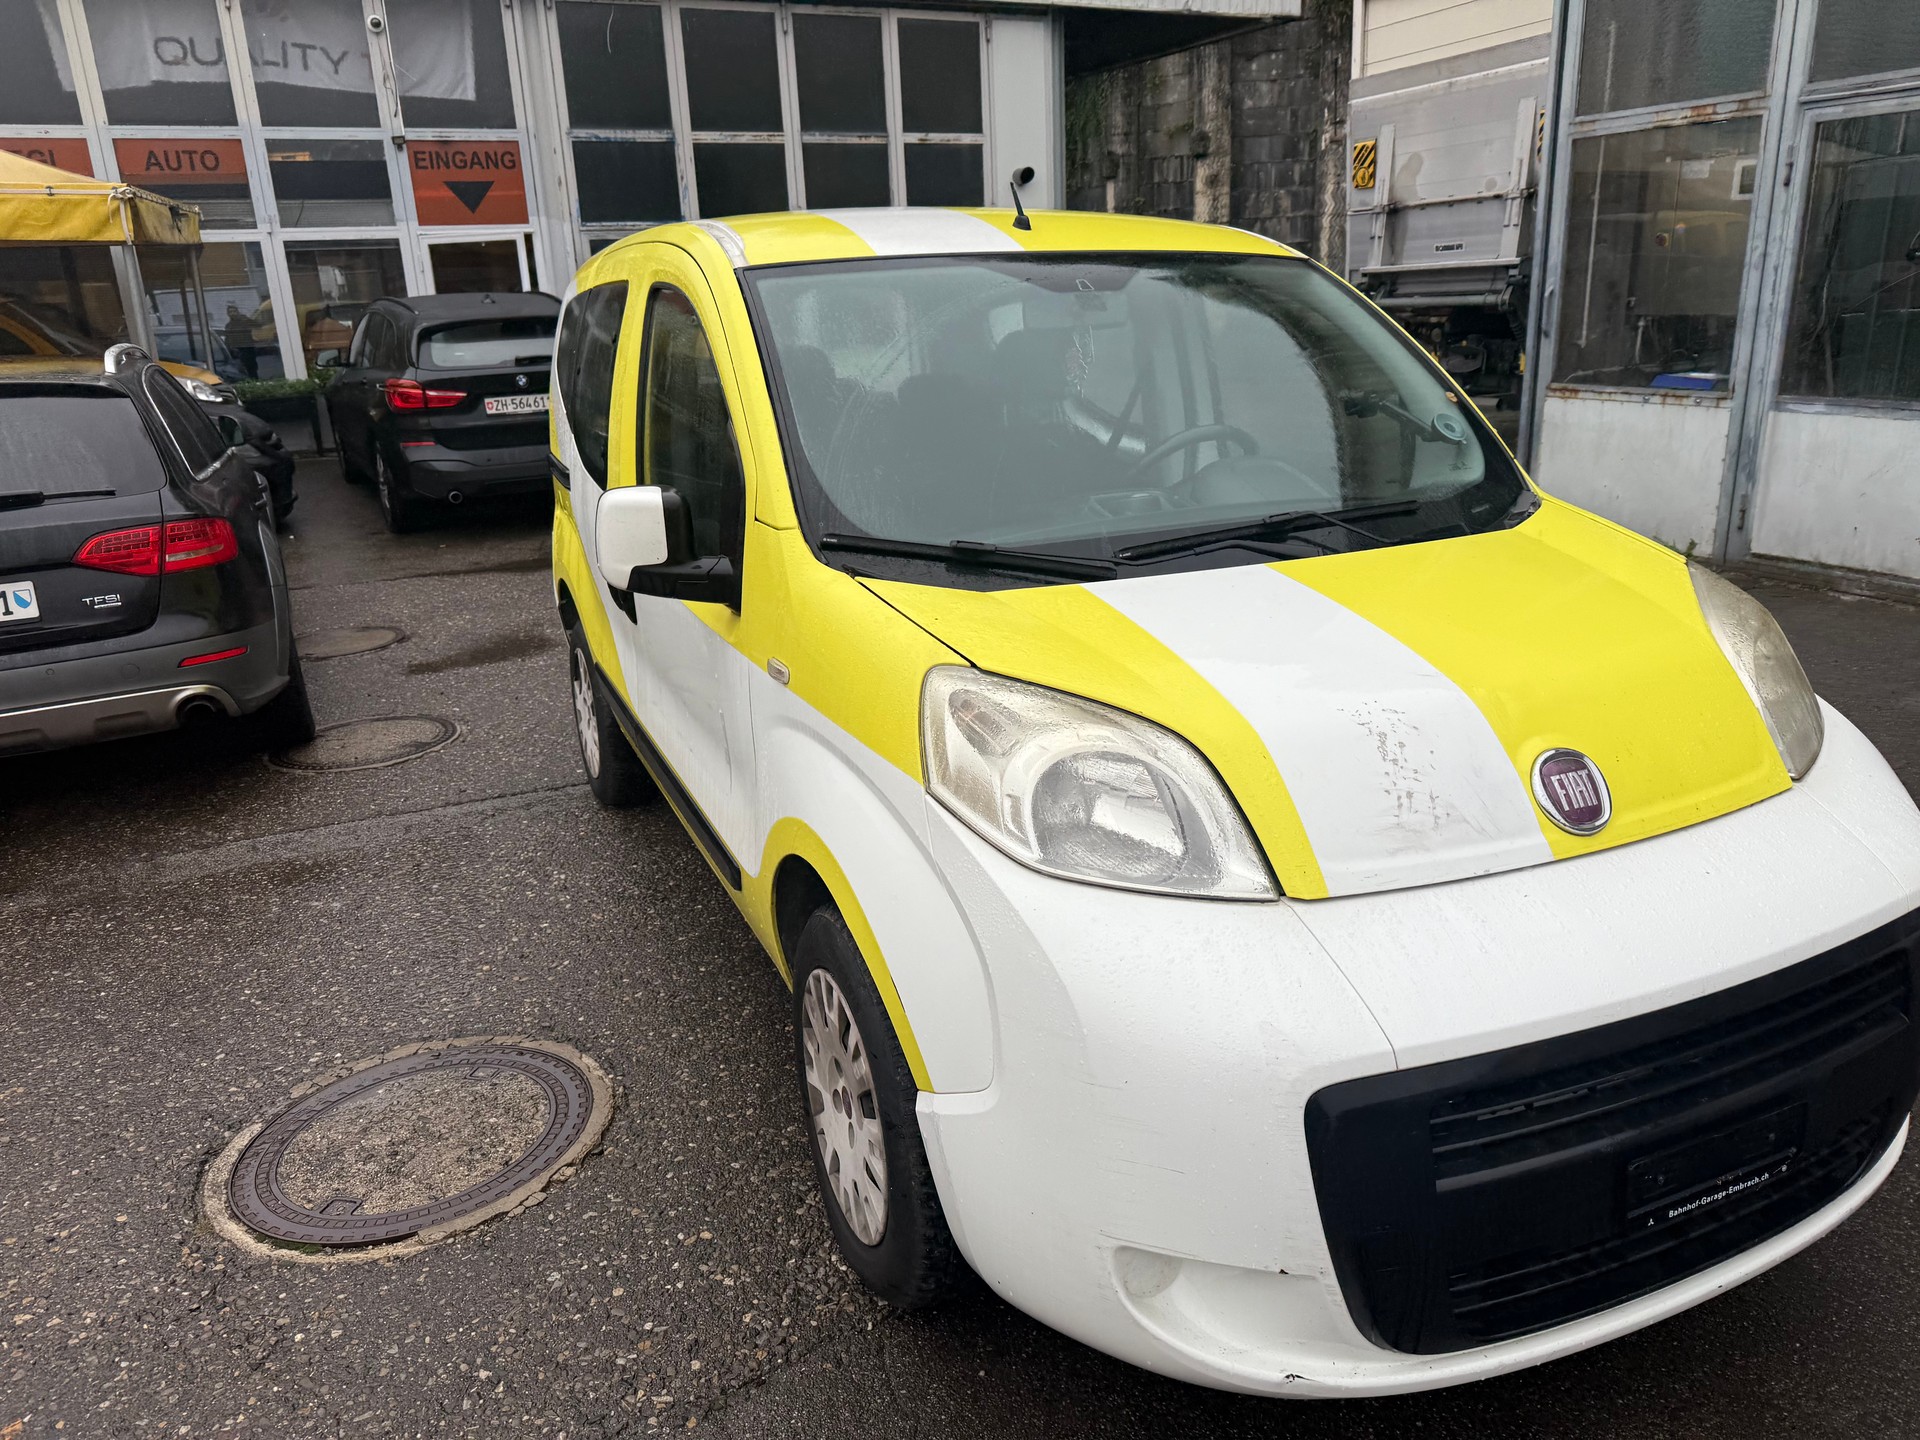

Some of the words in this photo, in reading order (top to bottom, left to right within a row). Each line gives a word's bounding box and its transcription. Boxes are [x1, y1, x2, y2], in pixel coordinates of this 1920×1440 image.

[153, 36, 349, 75] QULITY
[145, 149, 220, 171] AUTO
[413, 150, 516, 170] EINGANG
[81, 593, 121, 606] TFSI
[1550, 768, 1598, 812] FIAT
